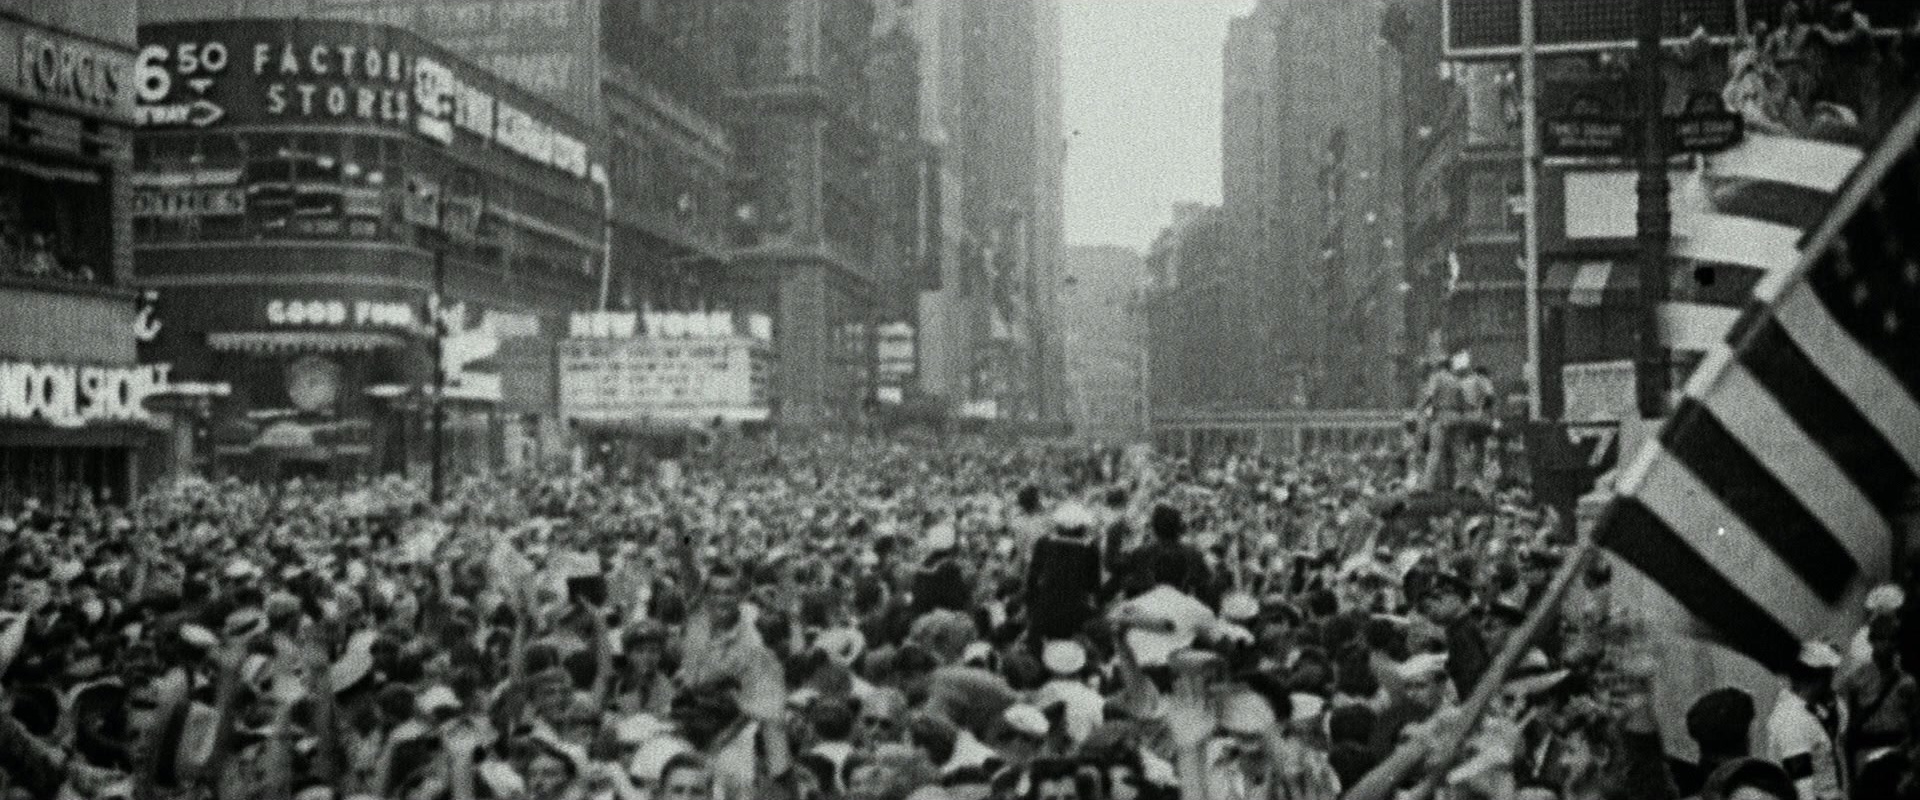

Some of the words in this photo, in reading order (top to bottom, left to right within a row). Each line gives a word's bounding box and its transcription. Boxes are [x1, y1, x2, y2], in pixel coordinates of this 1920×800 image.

[253, 43, 412, 81] FACTOR
[267, 84, 408, 121] STORES
[267, 301, 347, 324] GOOD
[1567, 427, 1617, 466] 7
